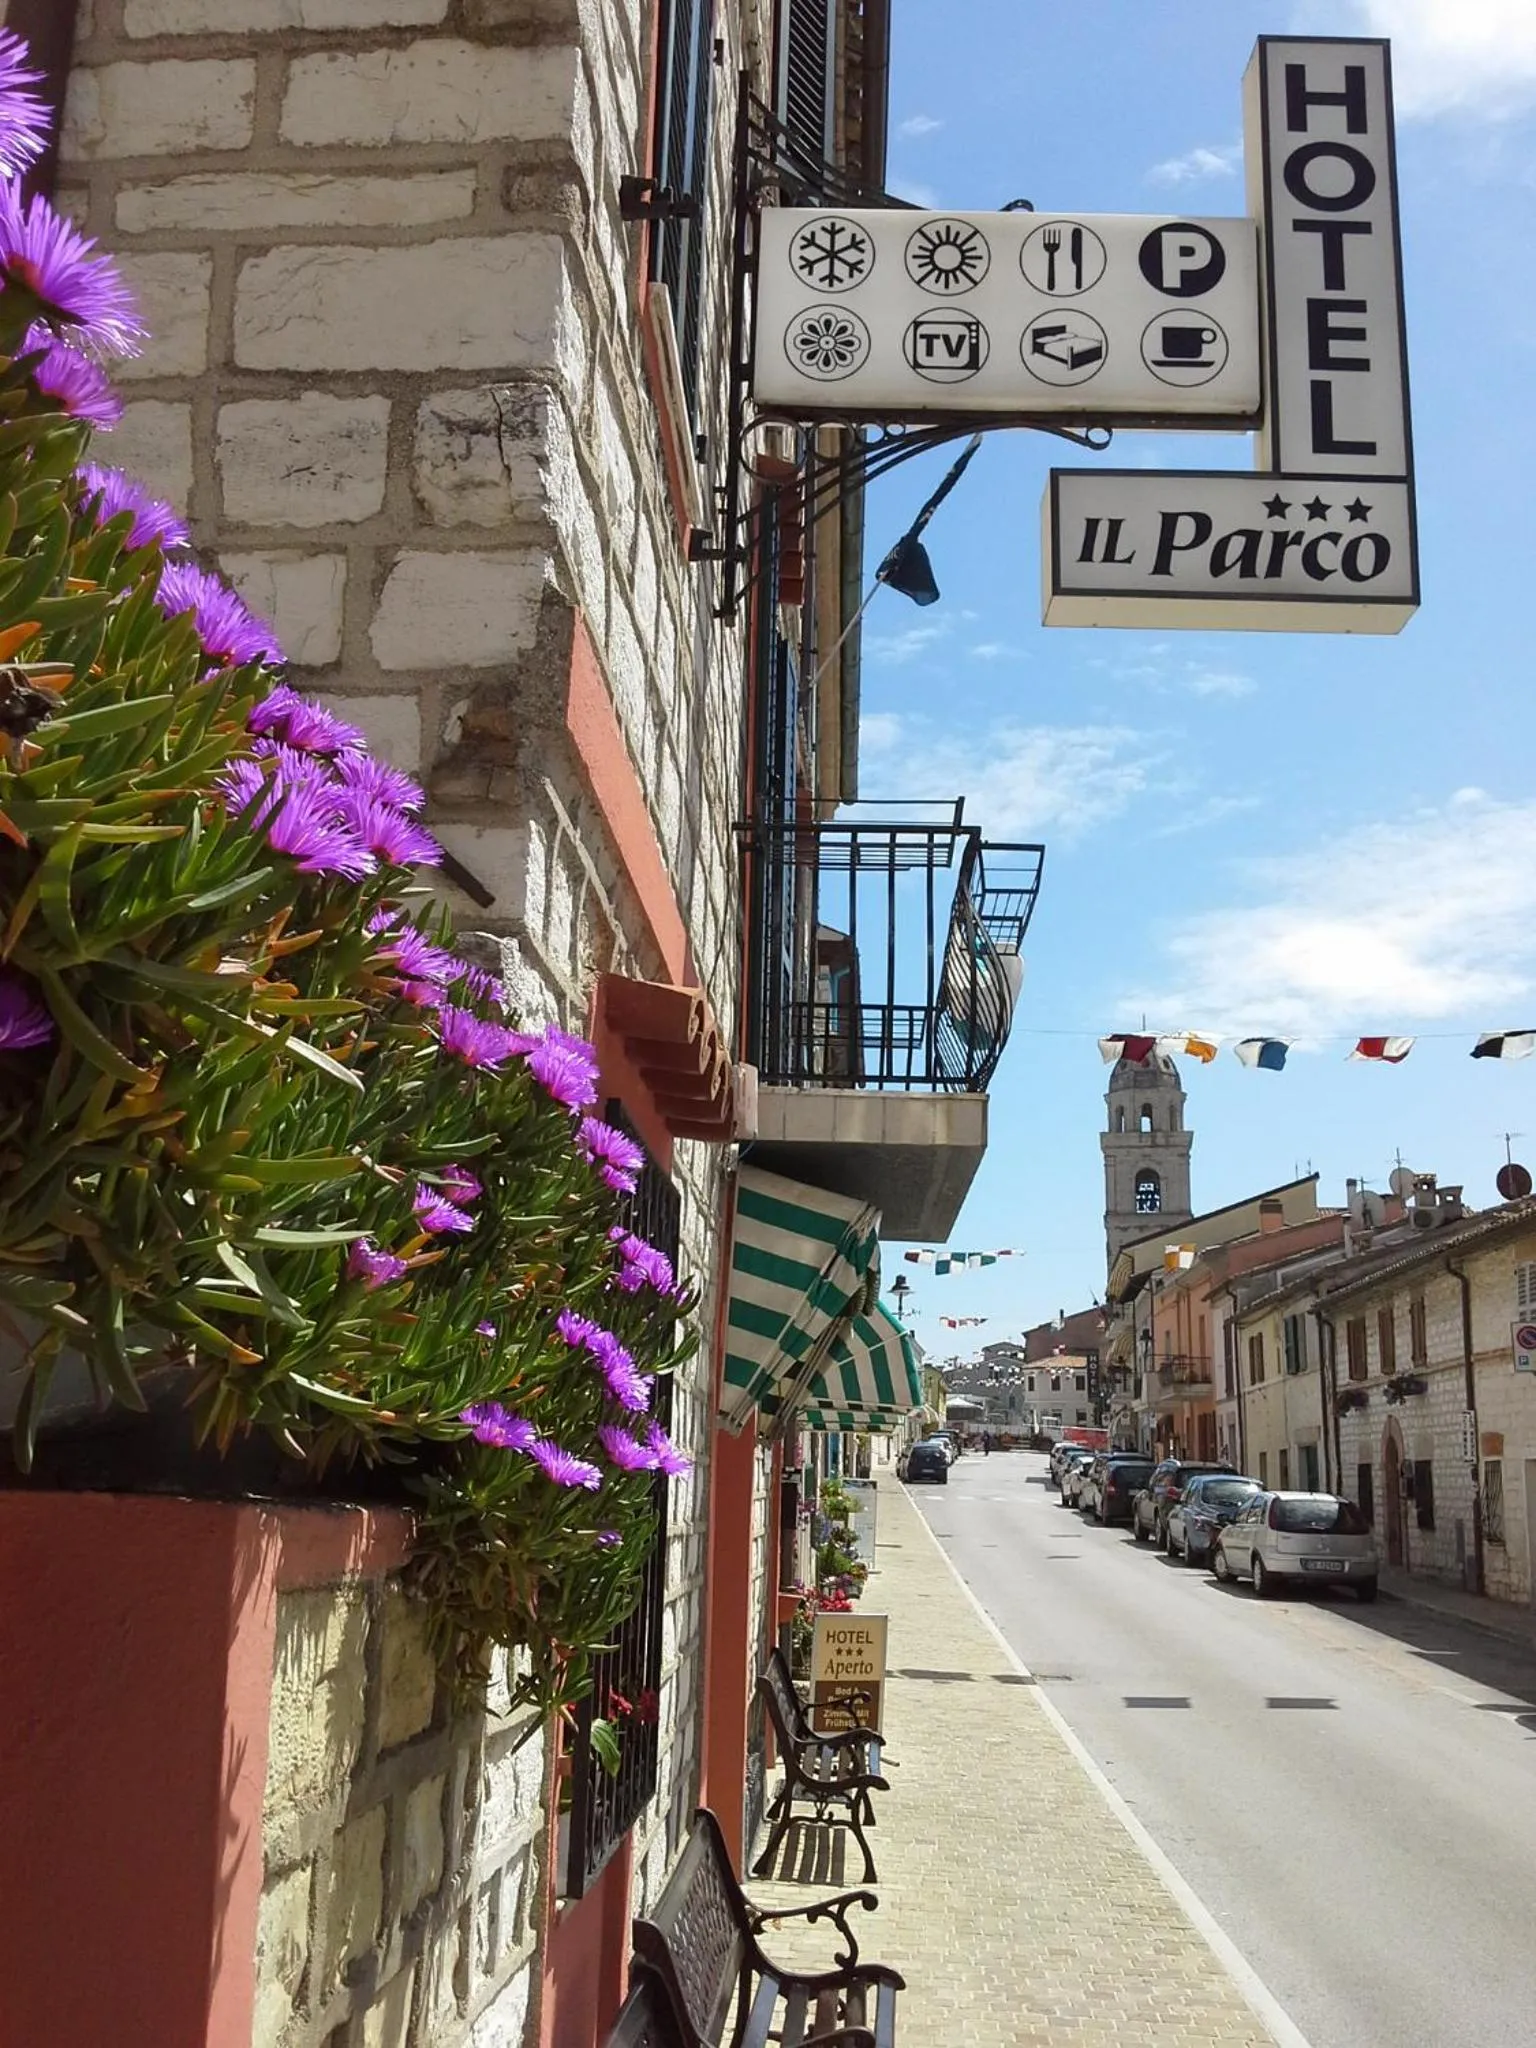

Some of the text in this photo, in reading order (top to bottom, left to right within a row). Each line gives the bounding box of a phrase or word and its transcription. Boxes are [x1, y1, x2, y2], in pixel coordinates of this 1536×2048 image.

[1161, 231, 1212, 289] P
[1284, 63, 1376, 456] HOTEL
[919, 333, 967, 358] TV
[1077, 510, 1391, 582] IL Parco
[1089, 1355, 1097, 1393] HOTEL
[826, 1630, 874, 1645] HOTEL
[824, 1658, 874, 1679] Aperto
[835, 1687, 852, 1696] Bed
